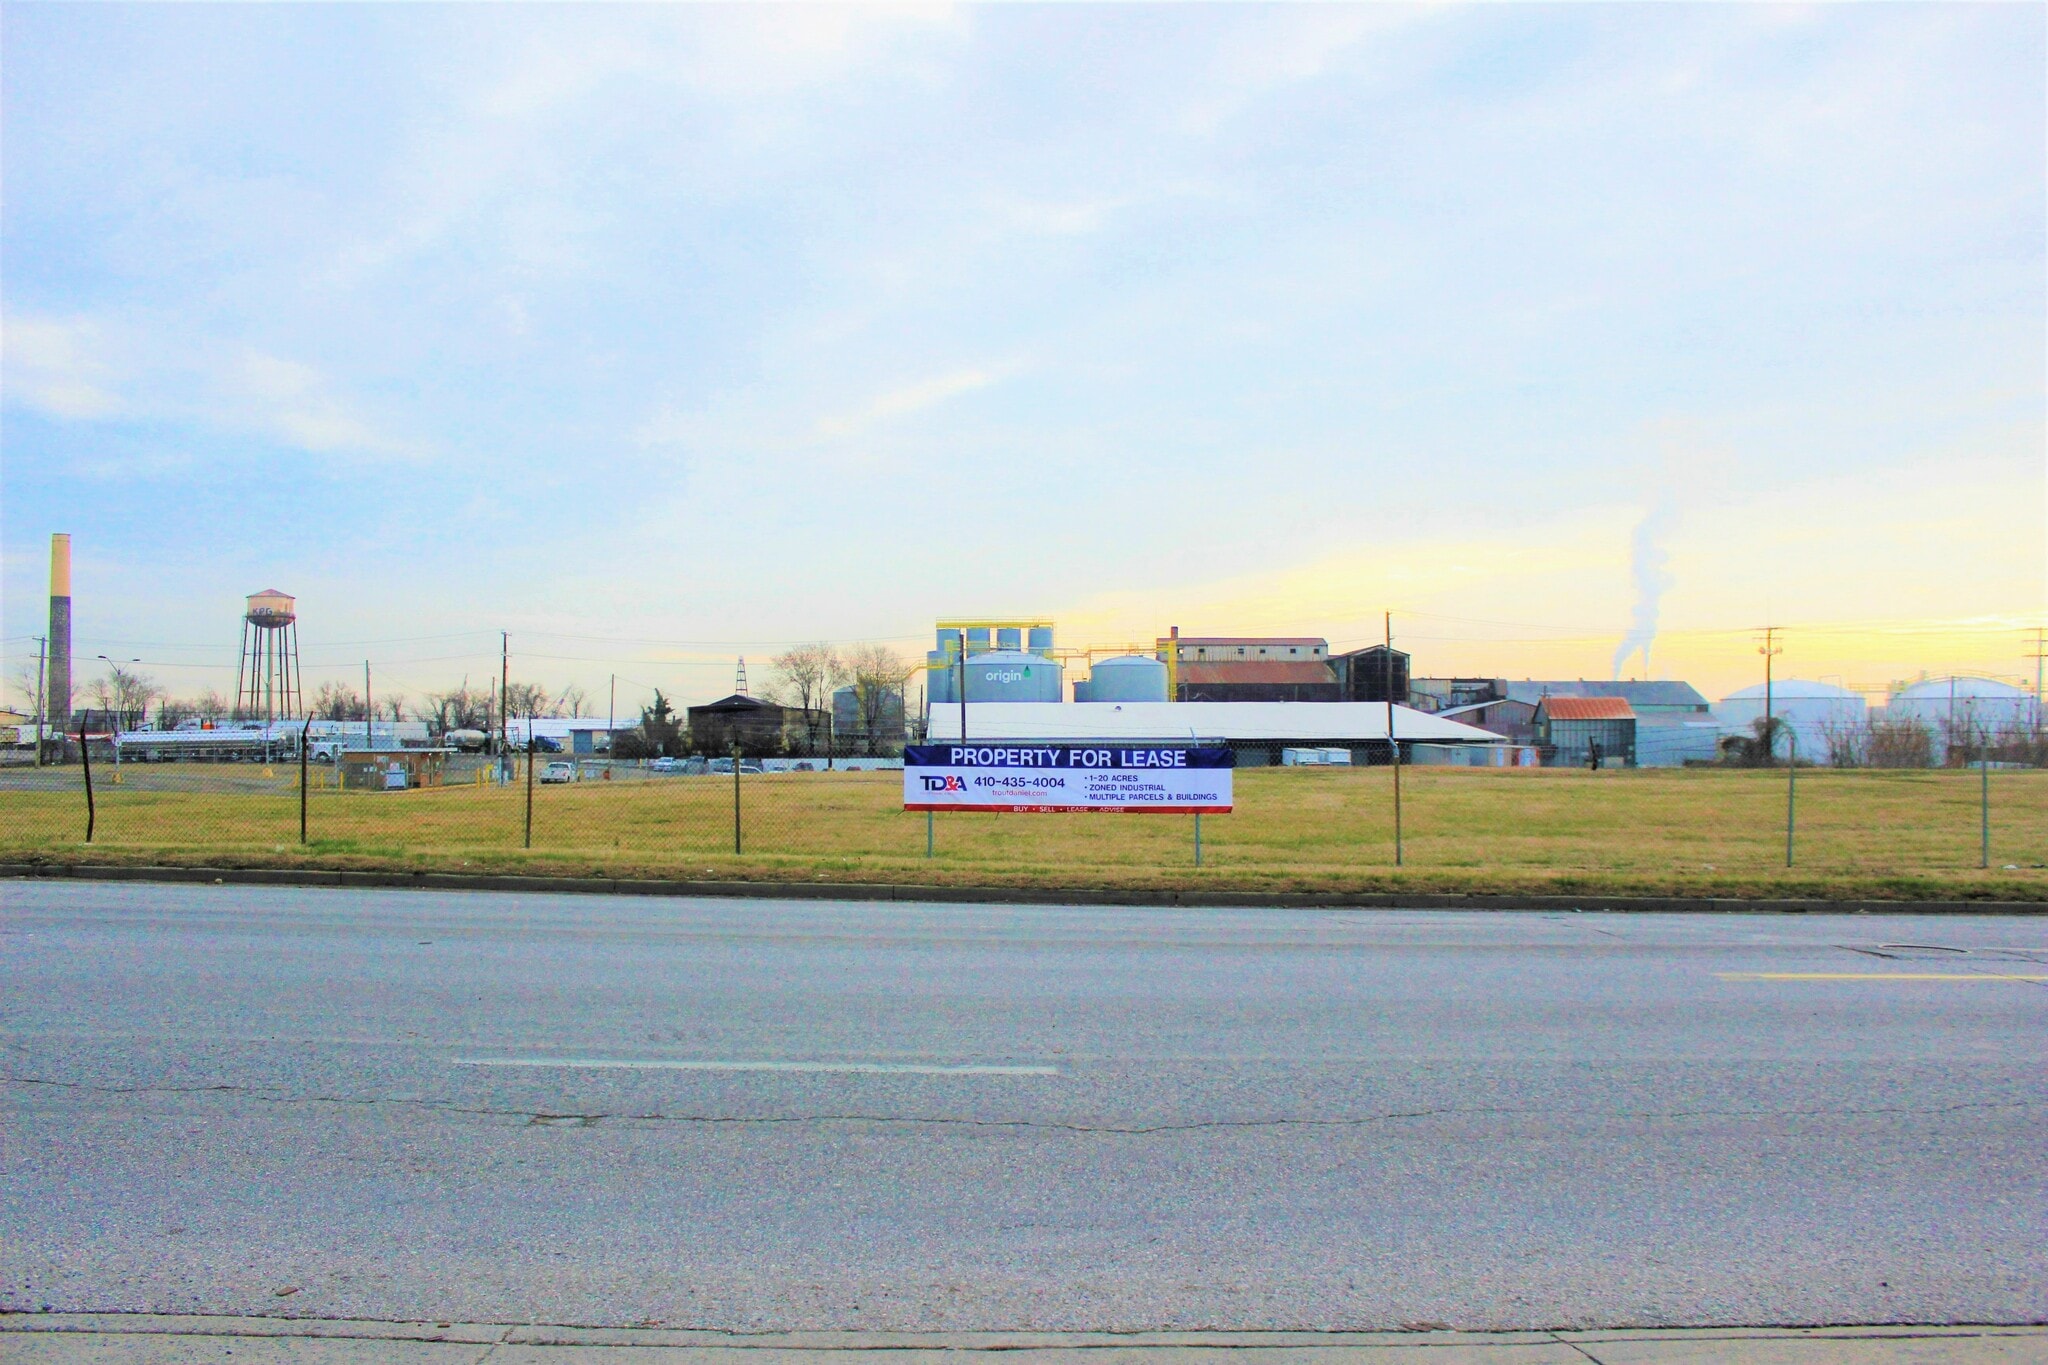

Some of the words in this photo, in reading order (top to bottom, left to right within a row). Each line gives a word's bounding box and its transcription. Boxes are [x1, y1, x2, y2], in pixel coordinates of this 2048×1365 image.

[985, 669, 1022, 684] origin
[951, 747, 1061, 767] PROPERTY
[1069, 749, 1112, 767] FOR
[1121, 750, 1186, 767] LEASE
[919, 775, 967, 792] TD&A
[974, 776, 1065, 788] 410-435-4004
[1120, 784, 1166, 792] INDUSTRIAL
[992, 789, 1048, 797] troutdaniel.com
[1089, 793, 1125, 801] MULTIPLE
[1128, 793, 1164, 801] PARCELS
[1176, 793, 1217, 801] BUILDINGS
